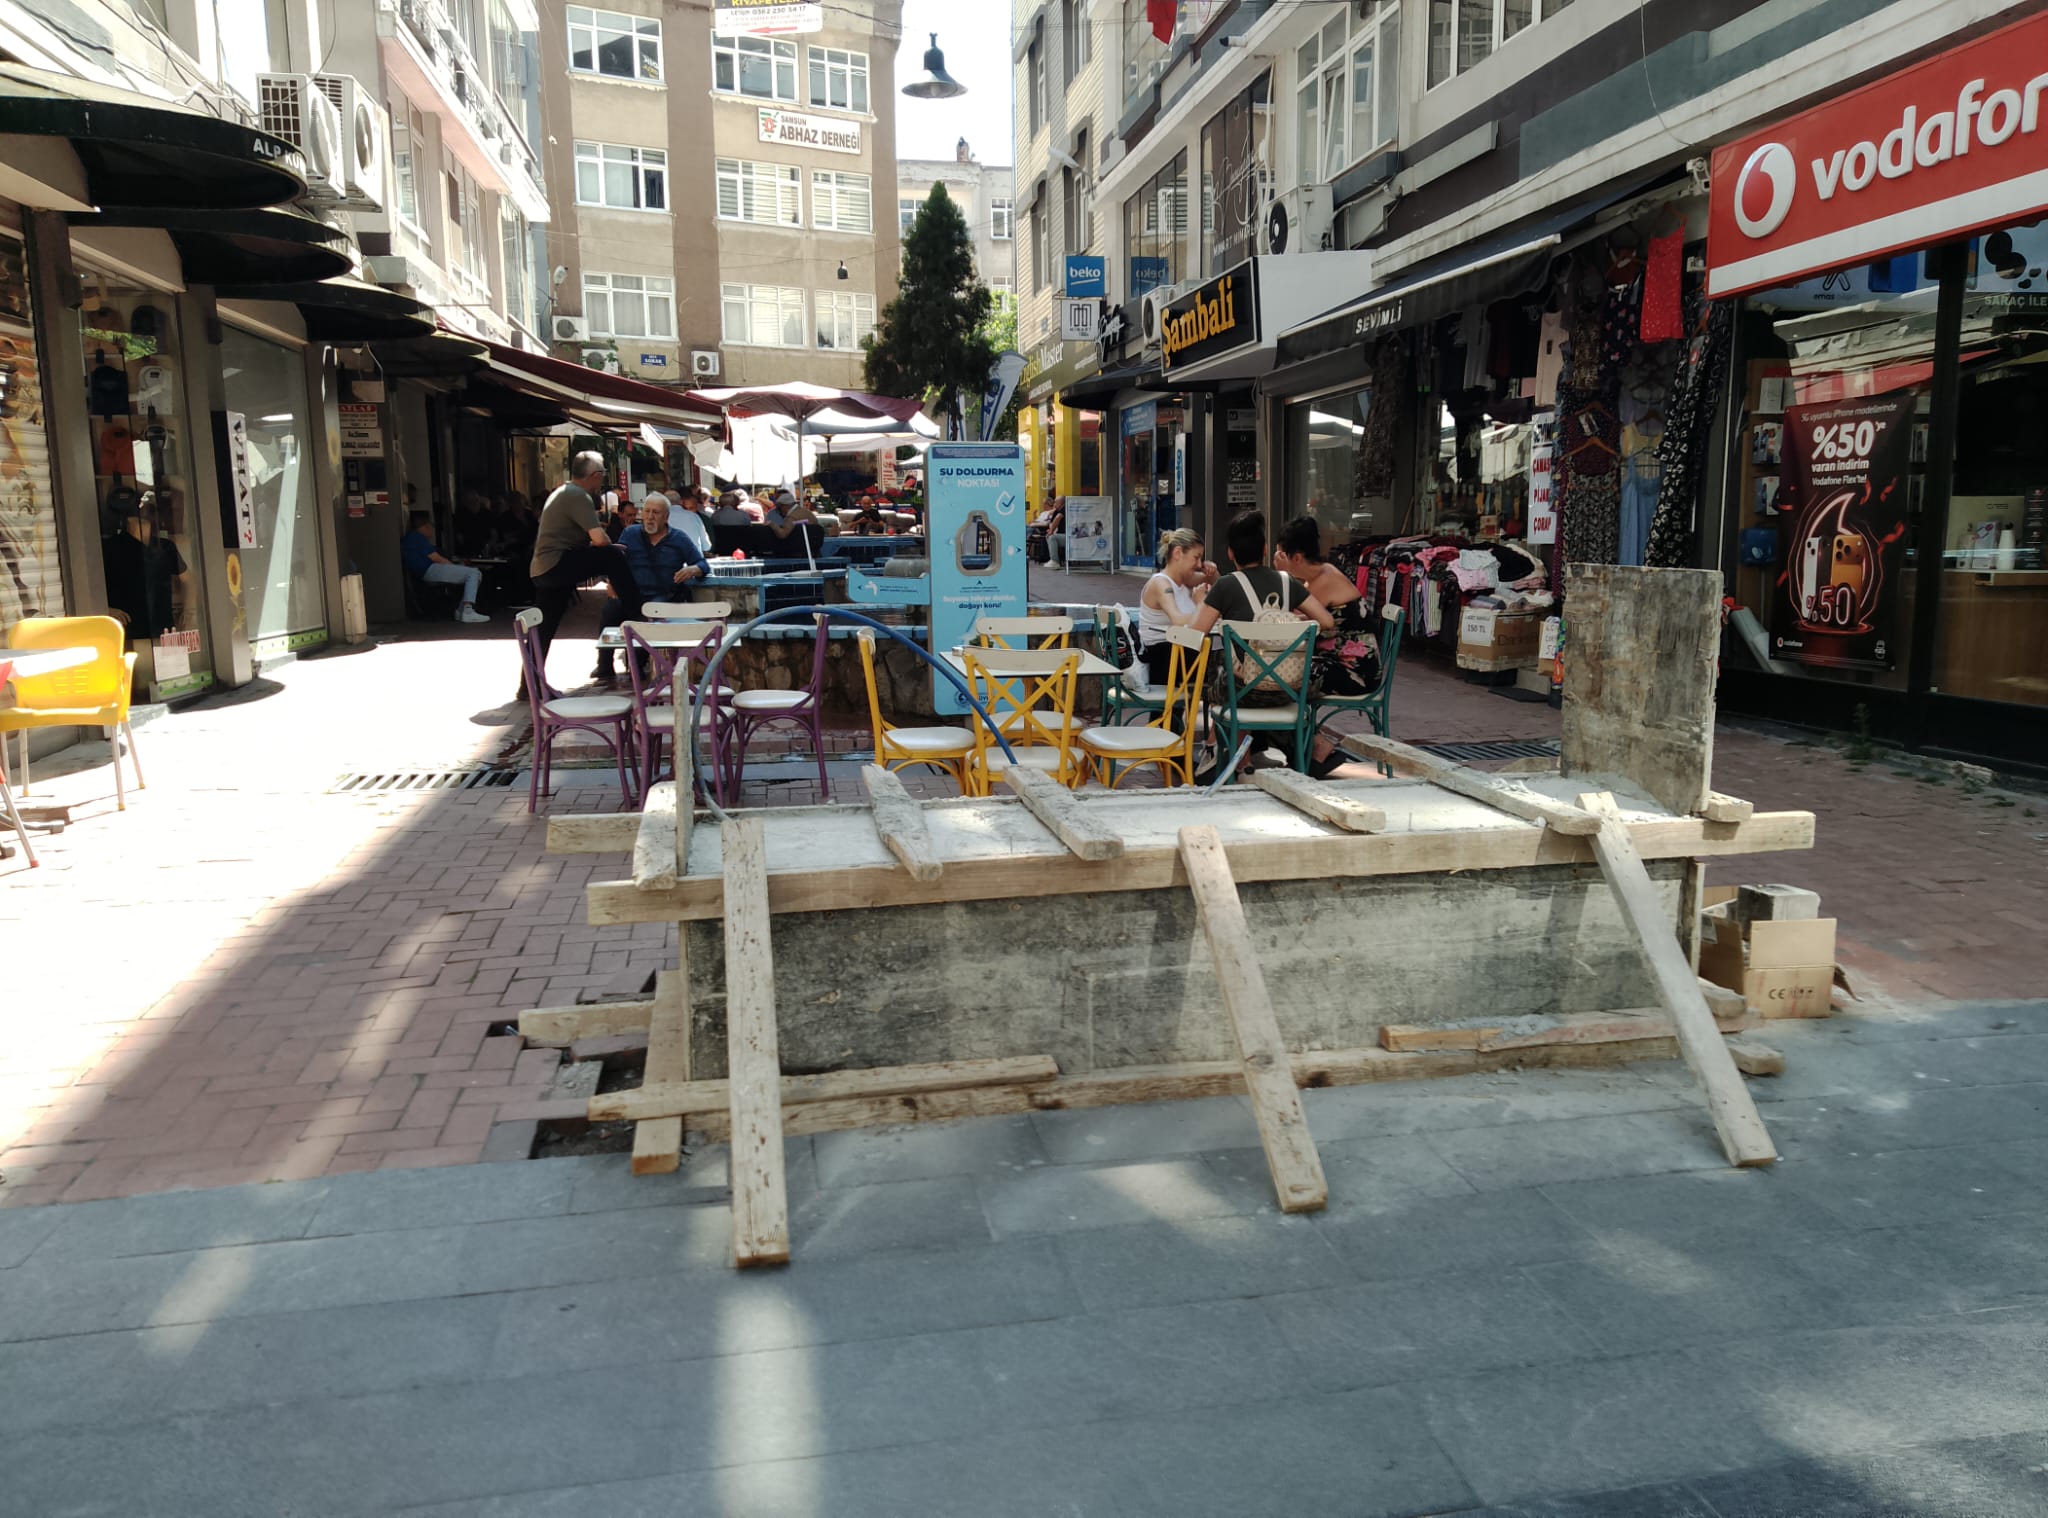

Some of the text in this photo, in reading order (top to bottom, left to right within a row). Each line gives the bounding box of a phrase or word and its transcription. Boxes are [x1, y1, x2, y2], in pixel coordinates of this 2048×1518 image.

[781, 115, 807, 126] SAMSUN
[779, 125, 860, 150] ABHAZ DERNEĞİ
[1811, 72, 2048, 200] vodafon
[253, 137, 282, 159] ALP
[1069, 266, 1101, 278] beko
[1984, 292, 2048, 308] SARAÇ İLE
[1355, 299, 1403, 334] SEVİMLİ
[940, 467, 1014, 476] SU DOLDURMA
[1175, 448, 1183, 492] beko
[1811, 459, 1870, 473] varan indirim
[957, 479, 1000, 488] NOKTASI
[1812, 476, 1841, 486] Vodafone
[958, 602, 983, 610] doğayı
